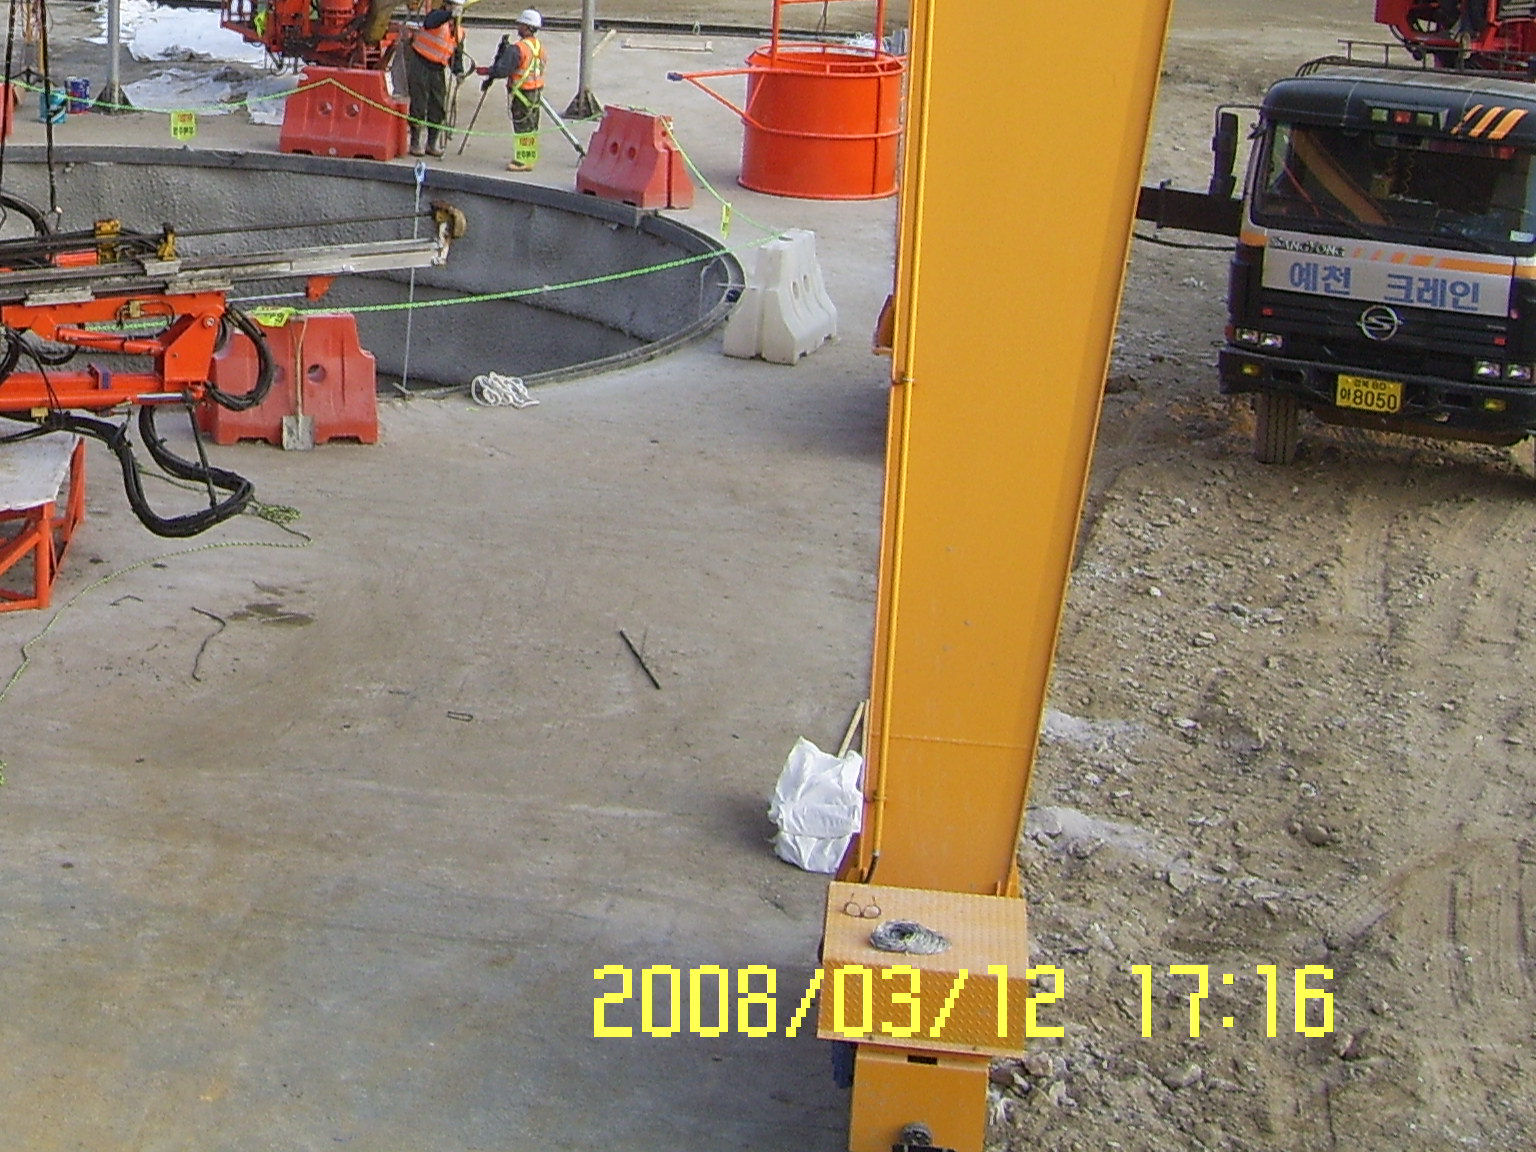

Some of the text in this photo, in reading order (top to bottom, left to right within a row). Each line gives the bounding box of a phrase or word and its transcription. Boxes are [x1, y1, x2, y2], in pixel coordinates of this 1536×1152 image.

[1289, 261, 1480, 311] 예천 크레인
[1353, 389, 1397, 410] 8050
